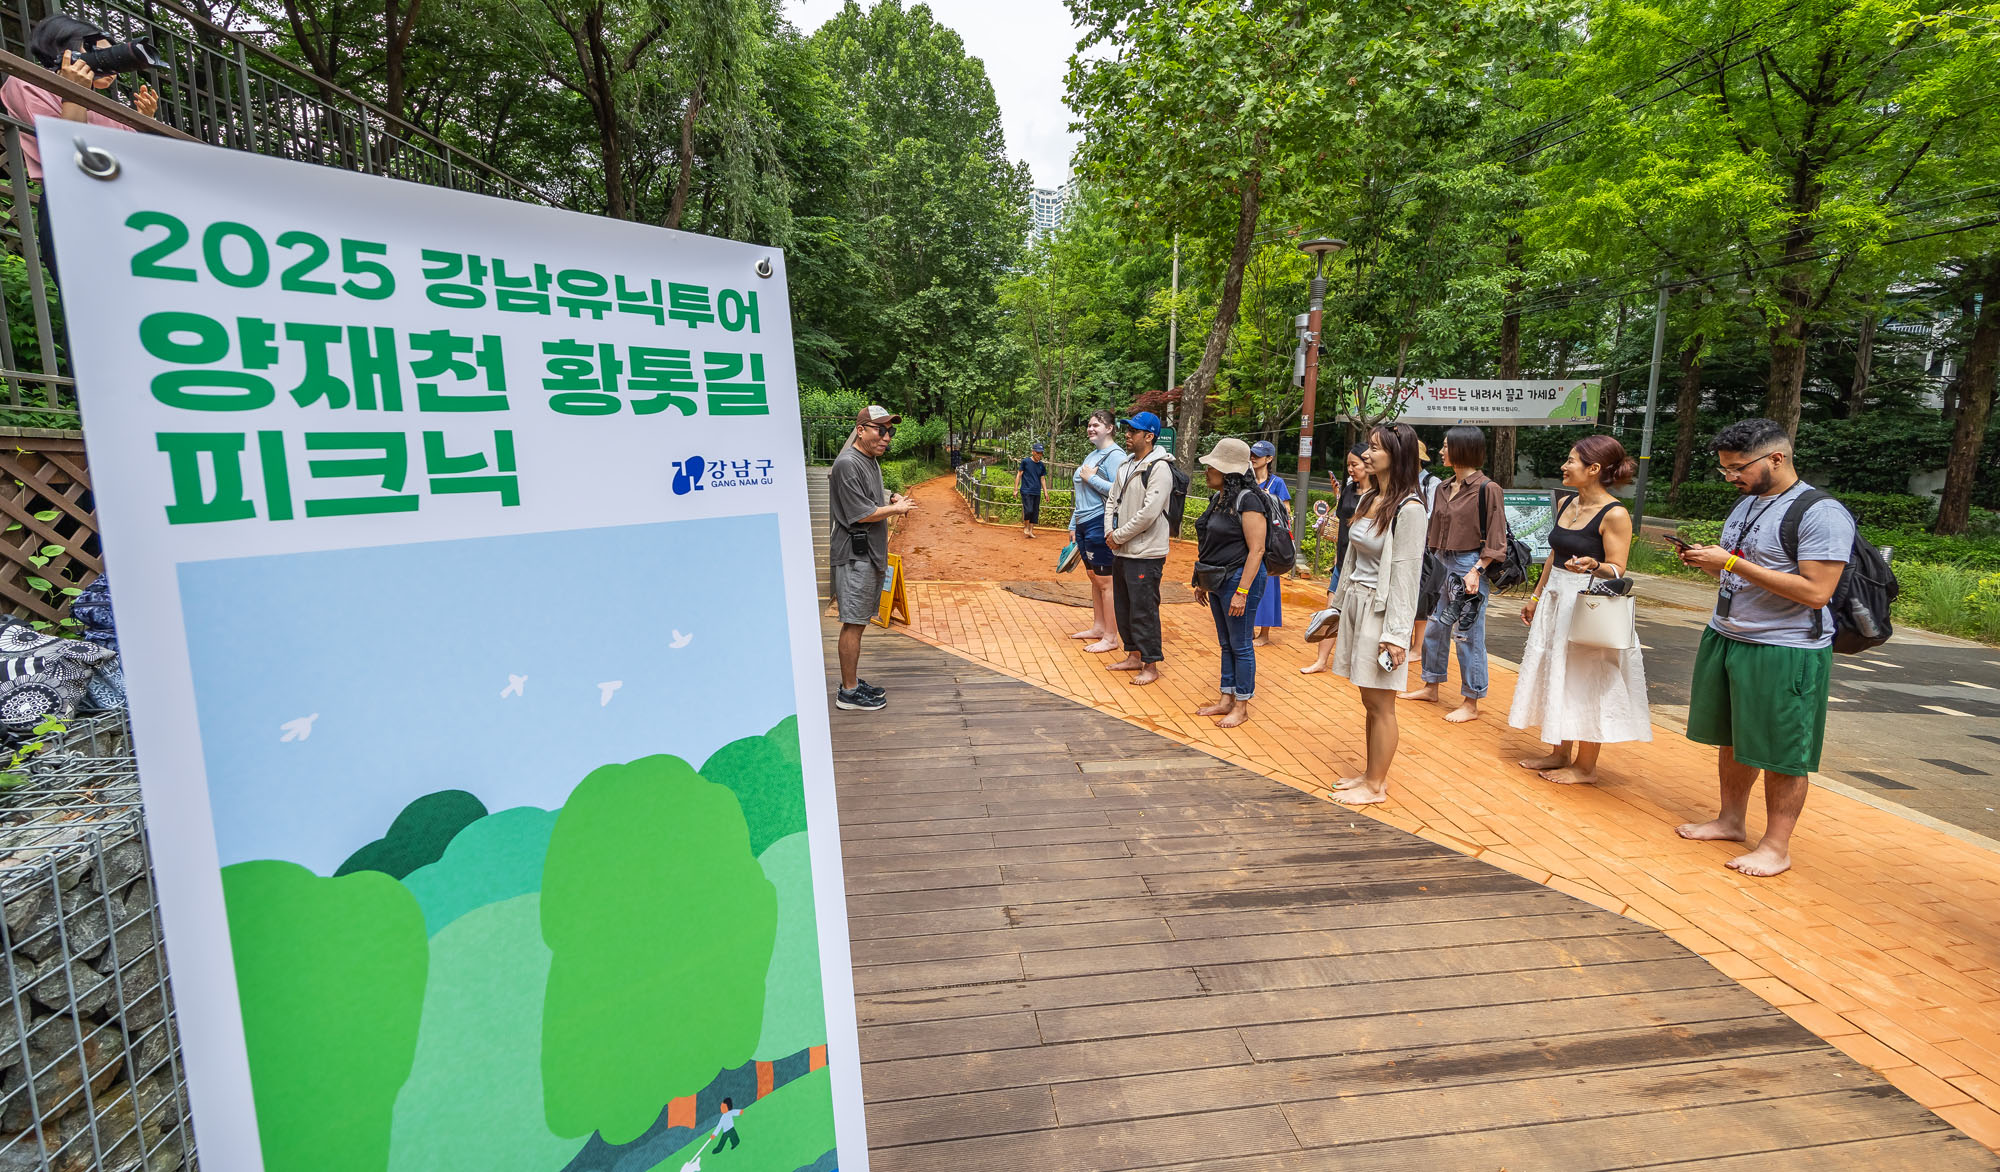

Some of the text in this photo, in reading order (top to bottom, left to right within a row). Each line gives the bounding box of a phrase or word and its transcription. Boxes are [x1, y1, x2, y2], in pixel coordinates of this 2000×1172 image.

[124, 210, 761, 334] 2025 강남유닉투어
[138, 311, 770, 417] 양재천 황톳길
[1428, 386, 1467, 402] 킥보드는
[1470, 388, 1502, 400] 내려서
[1505, 388, 1524, 402] 끌고
[155, 430, 521, 526] 피크닉
[707, 459, 774, 480] 강남구
[711, 477, 773, 488] GANG NAM GU
